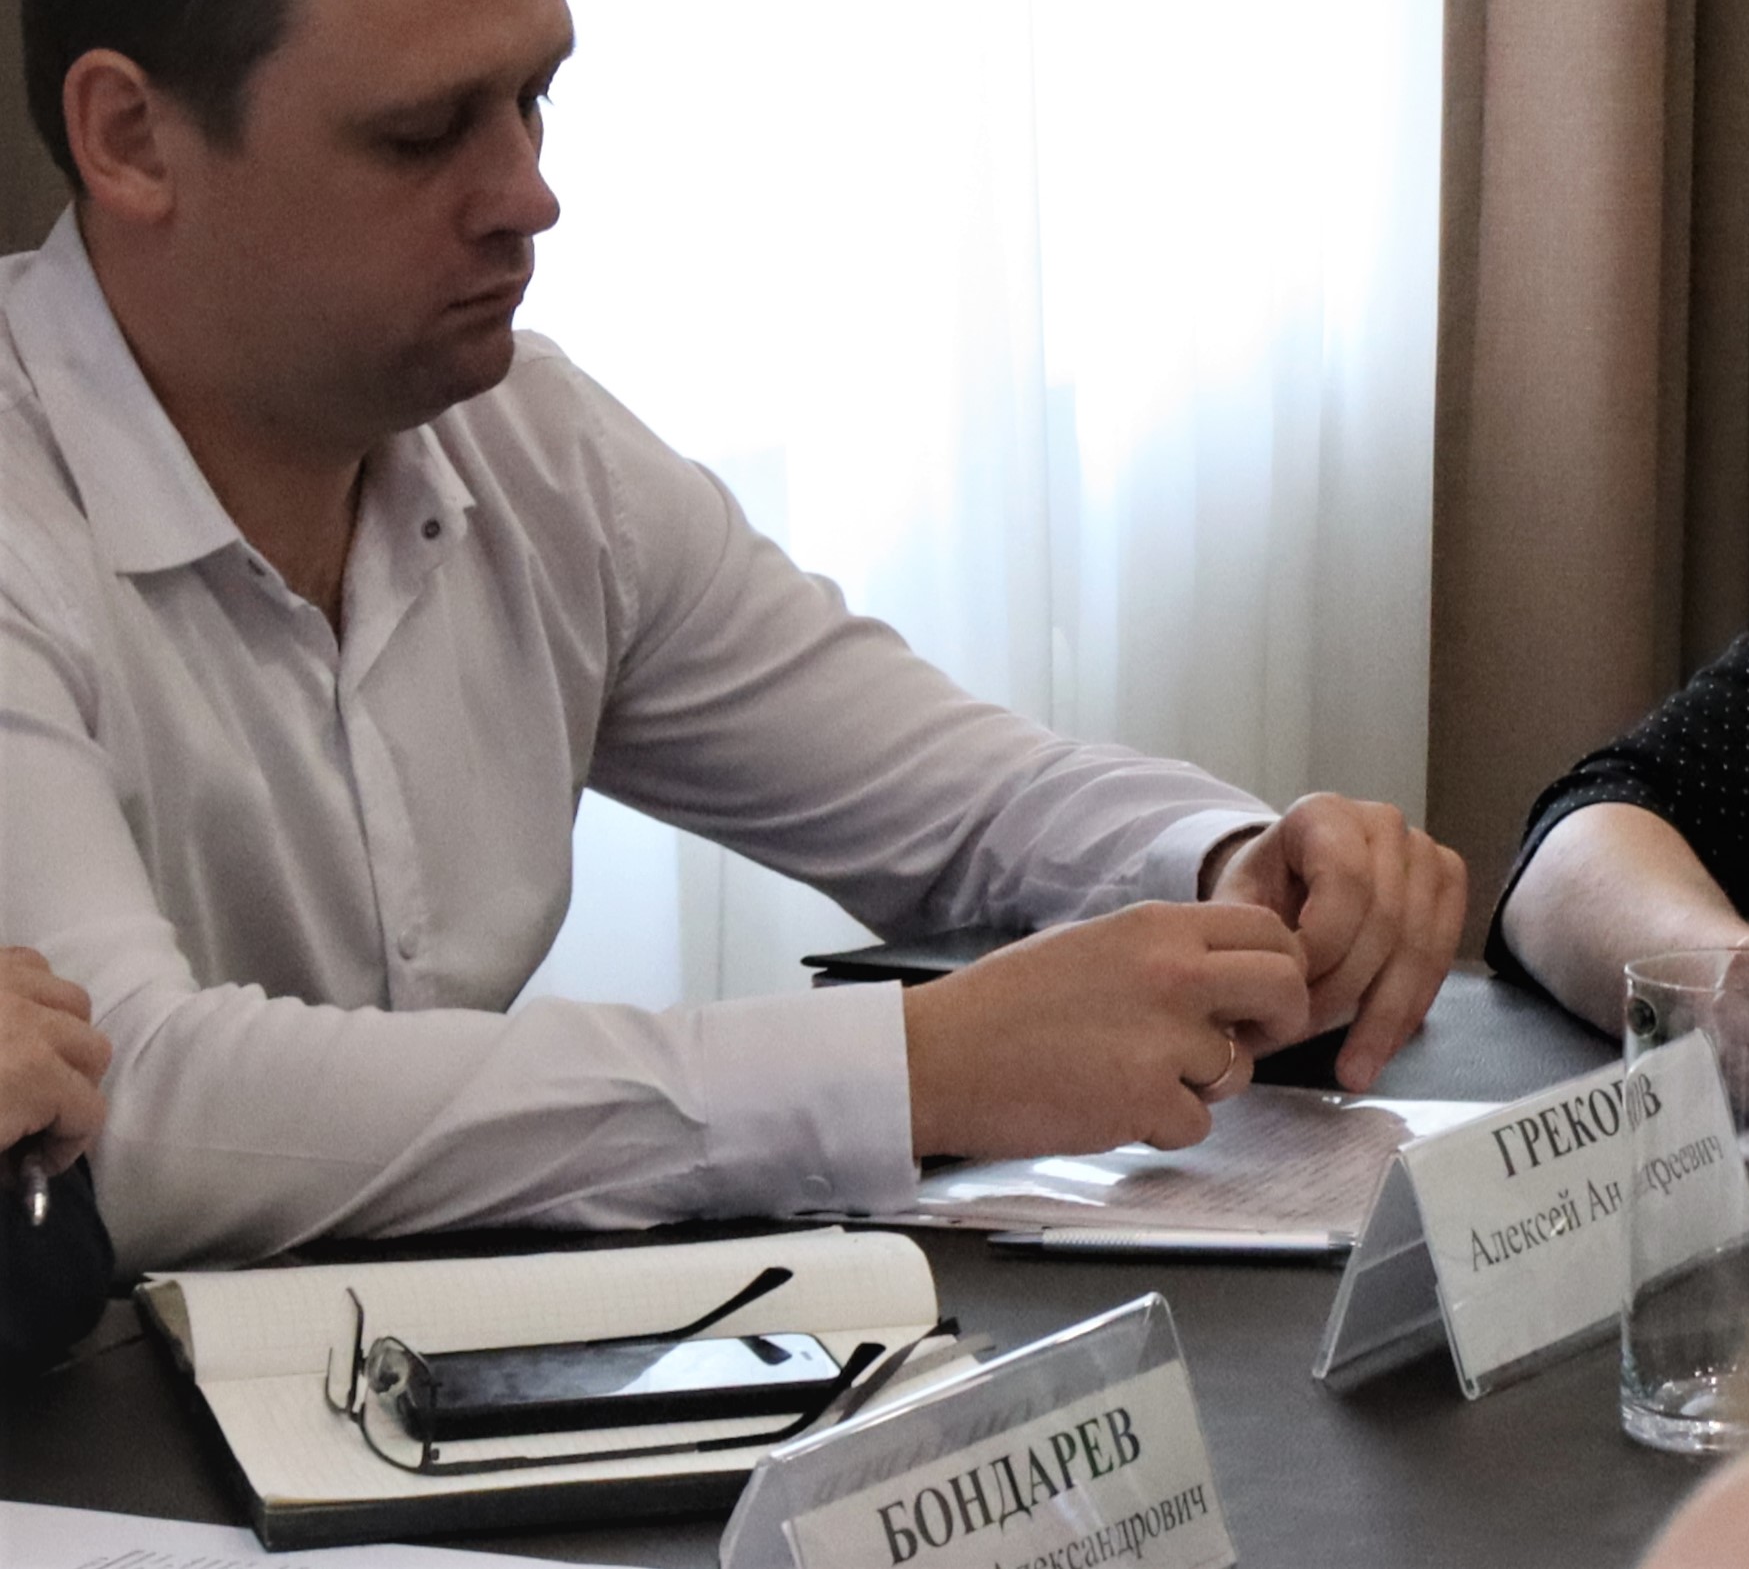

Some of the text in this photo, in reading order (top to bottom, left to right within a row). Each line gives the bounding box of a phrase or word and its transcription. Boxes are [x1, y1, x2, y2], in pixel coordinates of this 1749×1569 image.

[1491, 1073, 1662, 1178] ГРЕКОВ
[1470, 1188, 1582, 1272] Алексей
[877, 1407, 1142, 1567] БОНДАРЕВ
[994, 1484, 1208, 1569] ксандрович
